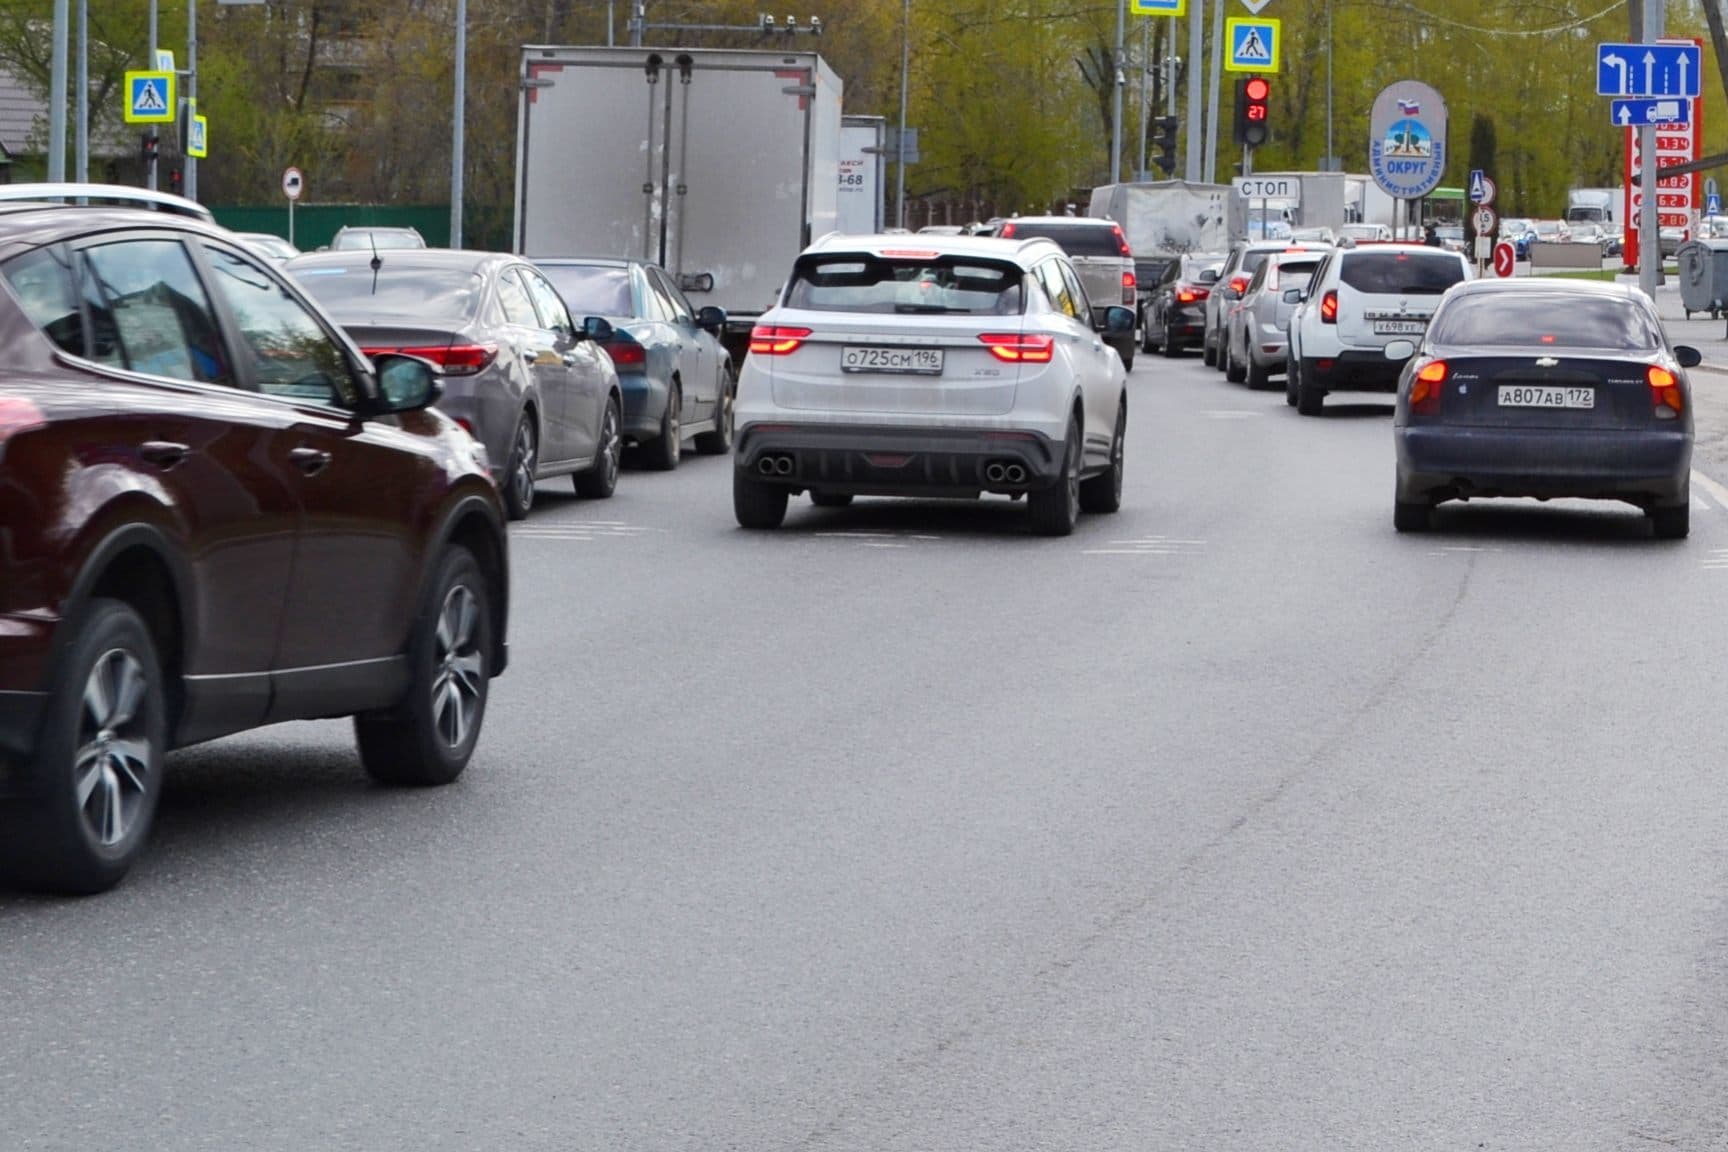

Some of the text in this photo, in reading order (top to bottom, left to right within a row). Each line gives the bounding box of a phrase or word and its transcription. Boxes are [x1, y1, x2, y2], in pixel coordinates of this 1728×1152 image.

[1249, 105, 1265, 119] 27
[1387, 160, 1427, 174] ОКРУГ
[1242, 181, 1288, 195] СТОП
[847, 349, 938, 367] О725СМ 196
[1503, 388, 1591, 406] А807АВ 172
